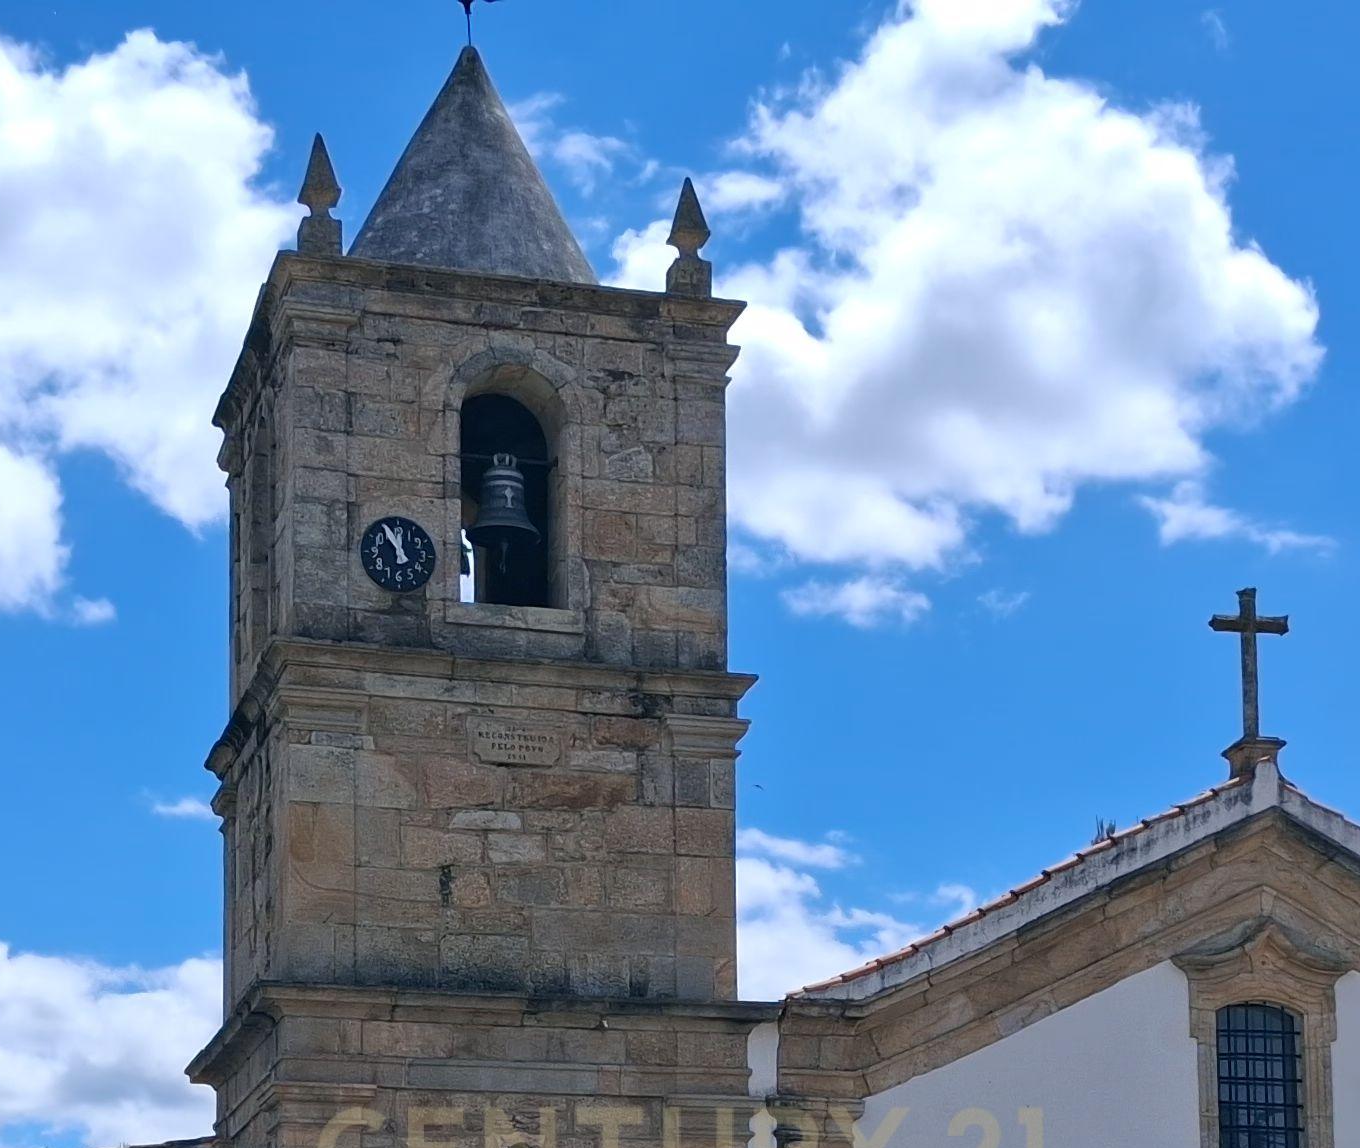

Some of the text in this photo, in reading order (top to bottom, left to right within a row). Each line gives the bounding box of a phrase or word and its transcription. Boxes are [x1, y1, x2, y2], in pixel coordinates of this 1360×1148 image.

[414, 537, 422, 549] 2
[371, 546, 379, 558] 9
[420, 550, 426, 562] 3
[376, 557, 383, 570] 8
[414, 562, 423, 573] 4
[384, 567, 390, 579] 7
[395, 570, 402, 581] 6
[407, 568, 414, 580] 5
